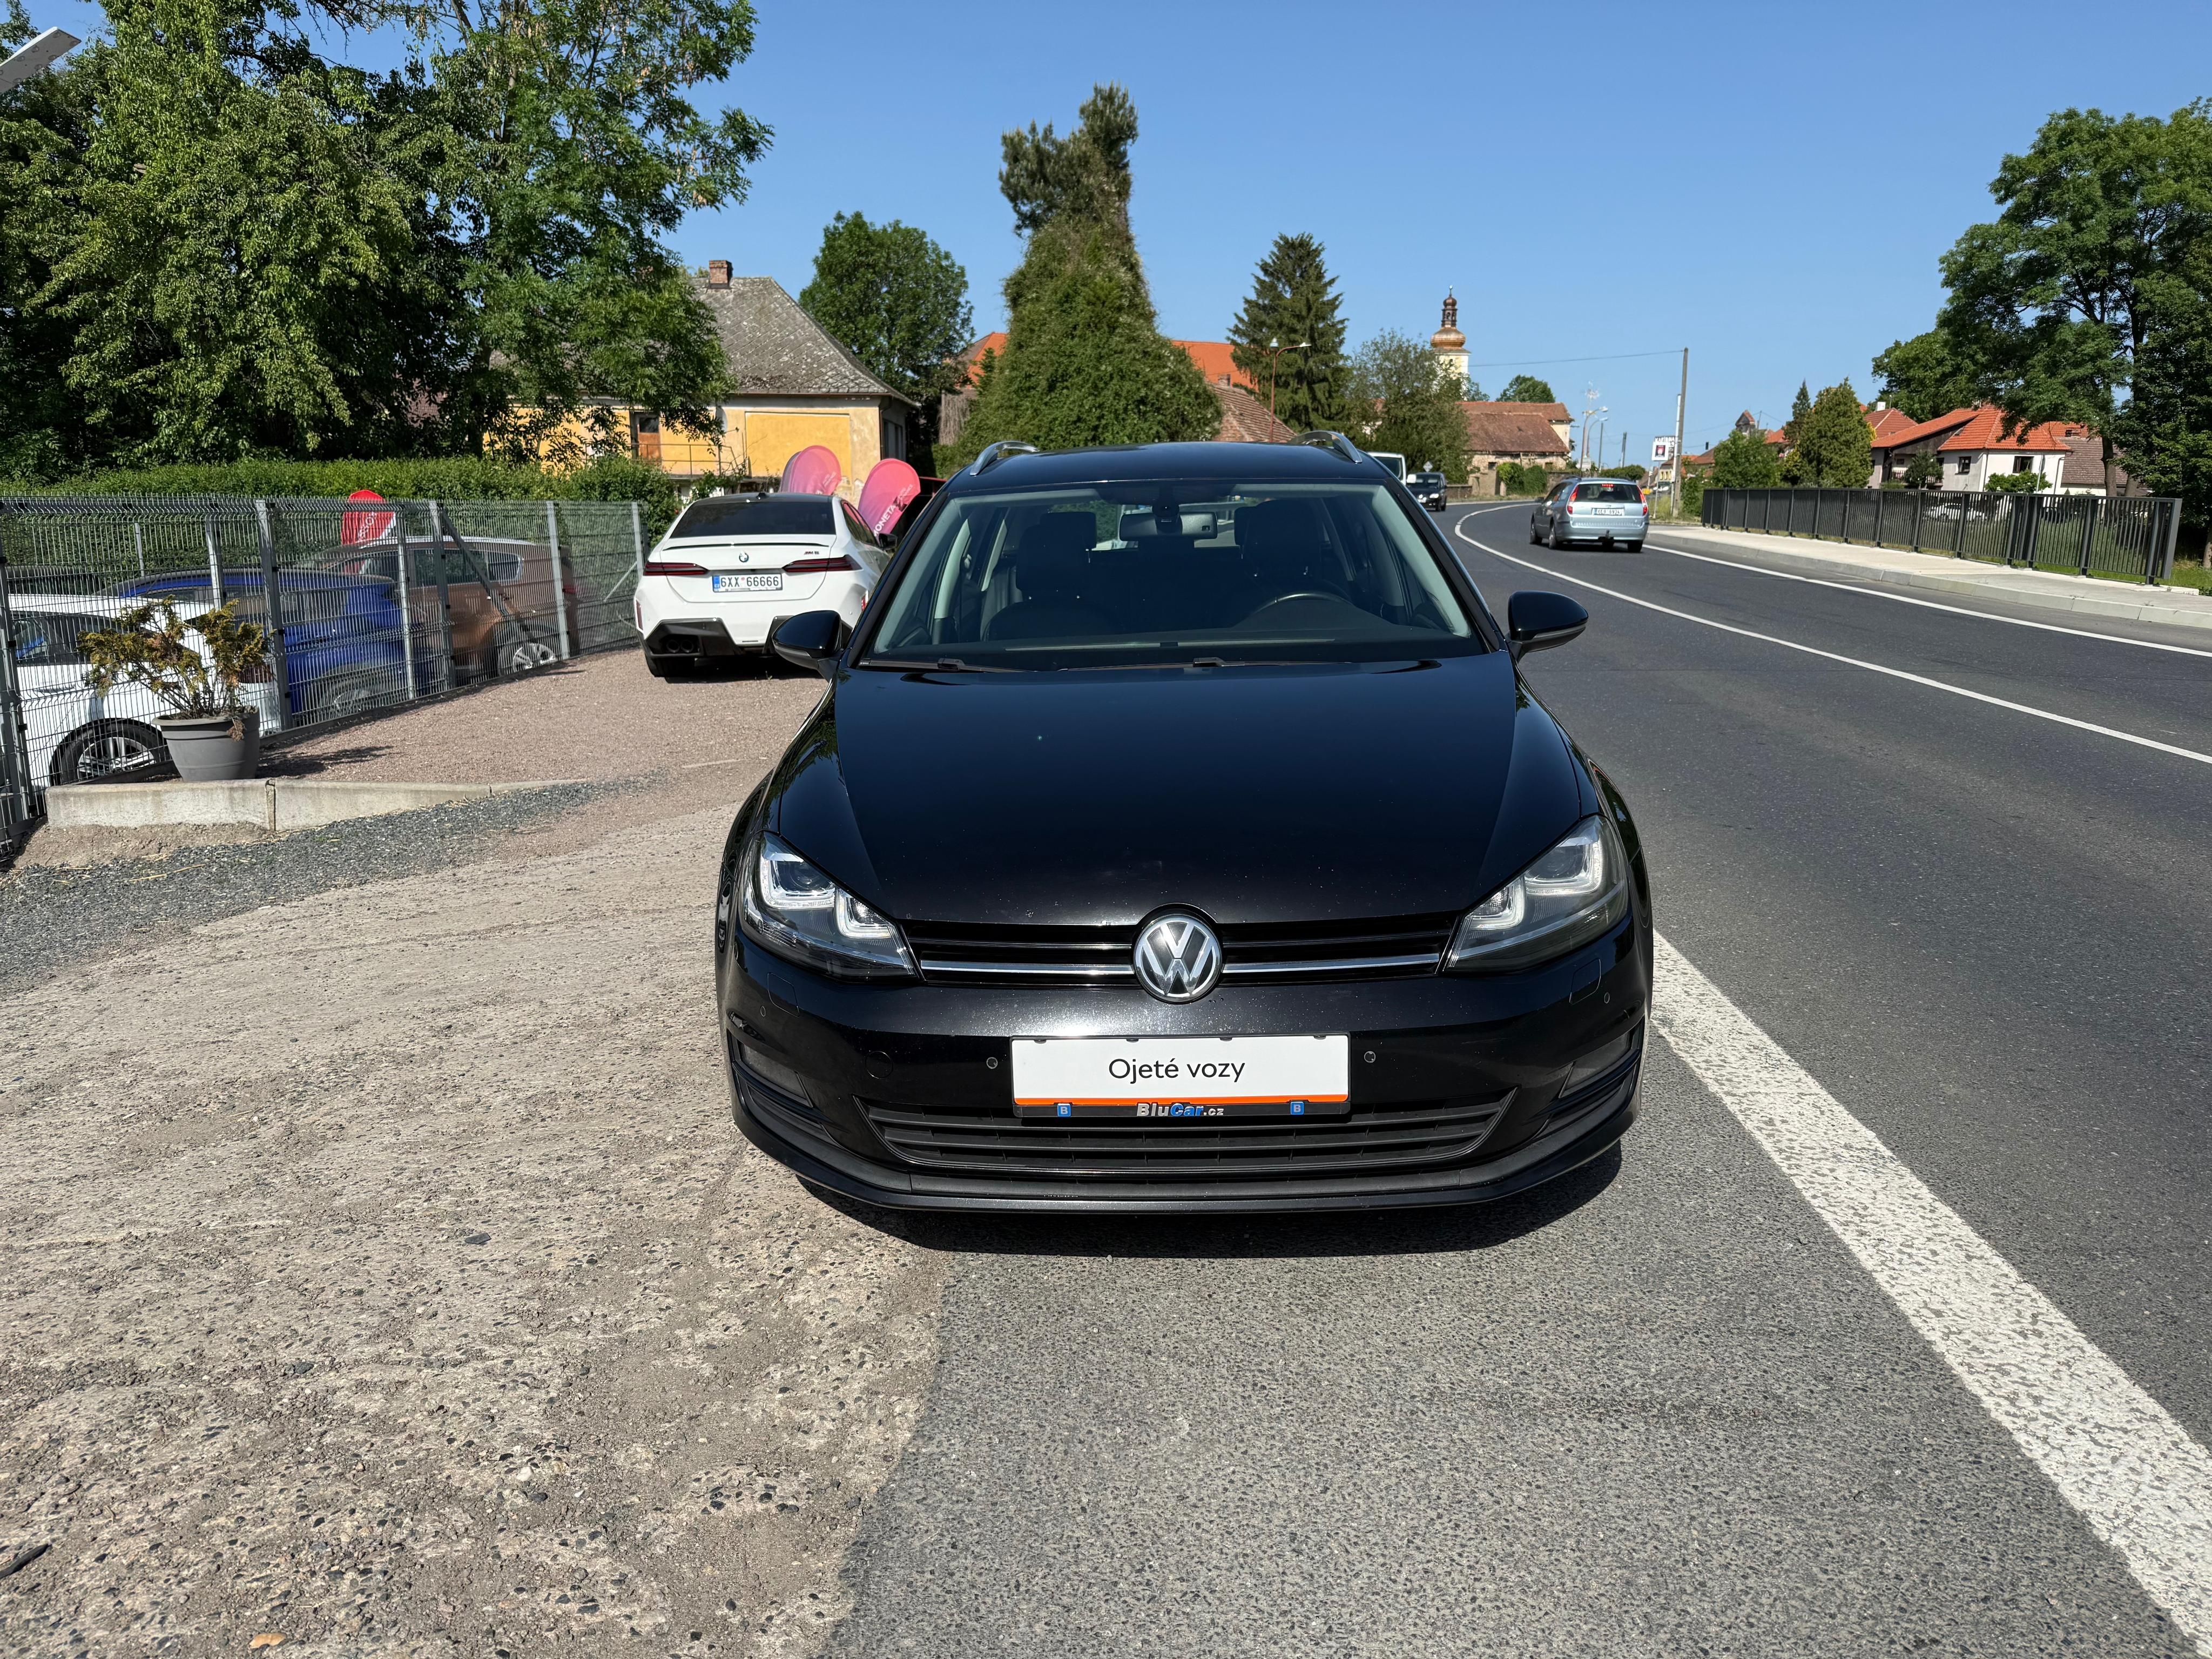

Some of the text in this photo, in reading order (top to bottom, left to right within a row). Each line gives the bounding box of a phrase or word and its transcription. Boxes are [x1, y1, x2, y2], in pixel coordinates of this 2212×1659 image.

[720, 576, 779, 587] 6XX 66666
[1109, 1058, 1245, 1084] Ojeté vozy
[1061, 1107, 1068, 1115] B
[1137, 1103, 1224, 1116] BluCar.cz
